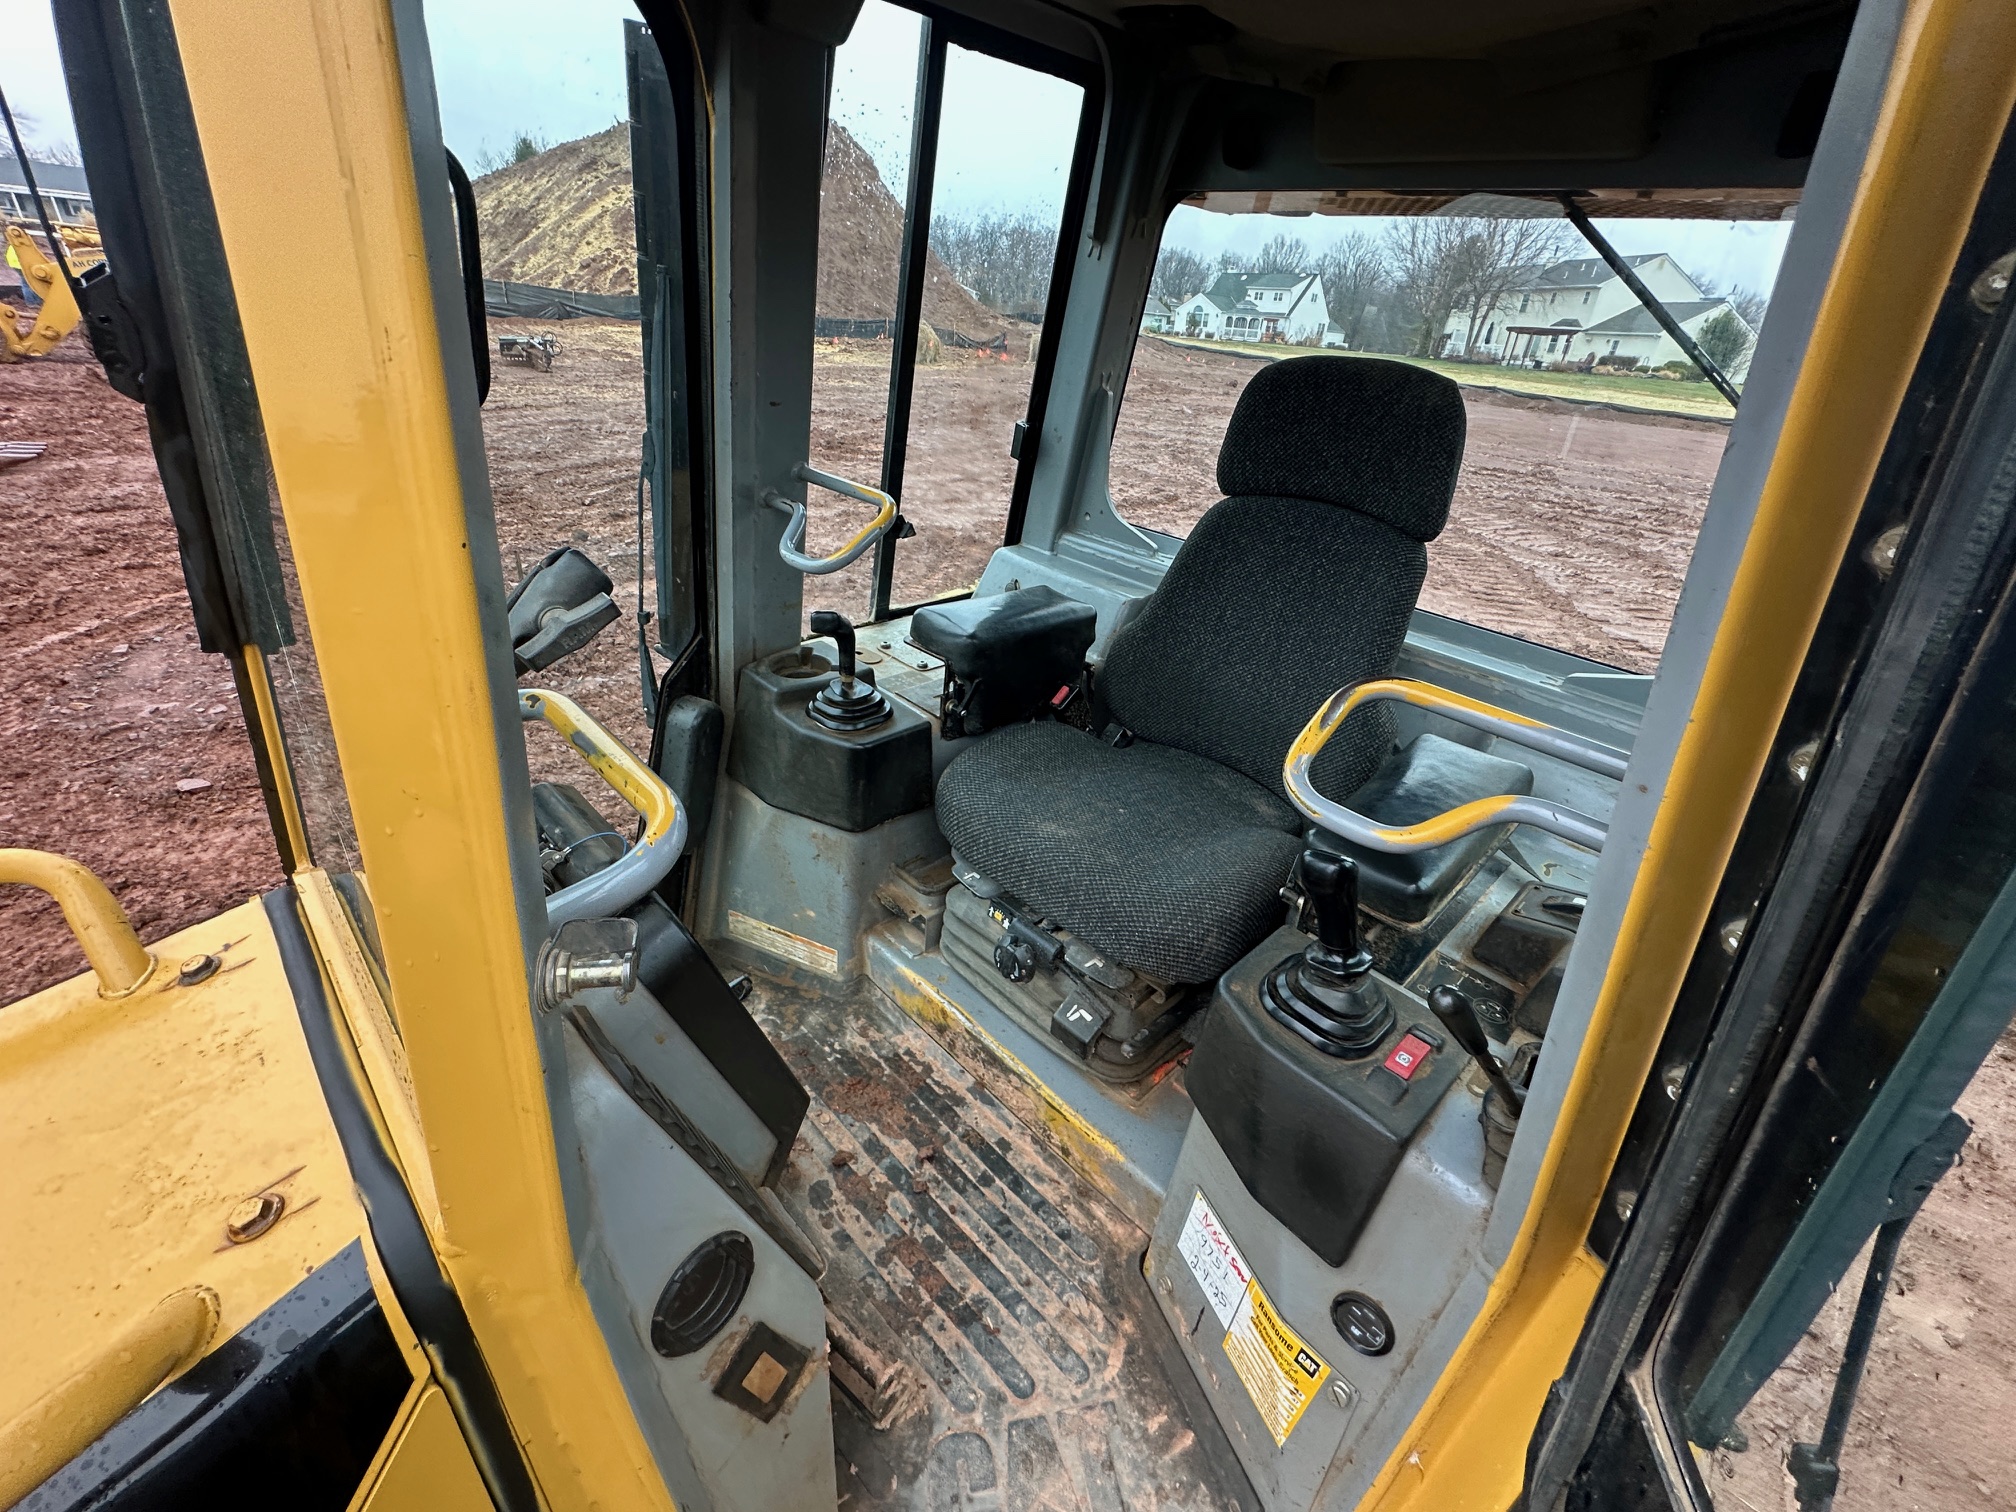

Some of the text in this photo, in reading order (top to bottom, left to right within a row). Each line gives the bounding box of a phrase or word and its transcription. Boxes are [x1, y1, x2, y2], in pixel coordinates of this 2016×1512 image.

[1201, 1234, 1228, 1280] 9751
[1258, 1301, 1294, 1352] Ransome
[1279, 1361, 1300, 1386] Branch
[1297, 1352, 1319, 1373] CAT
